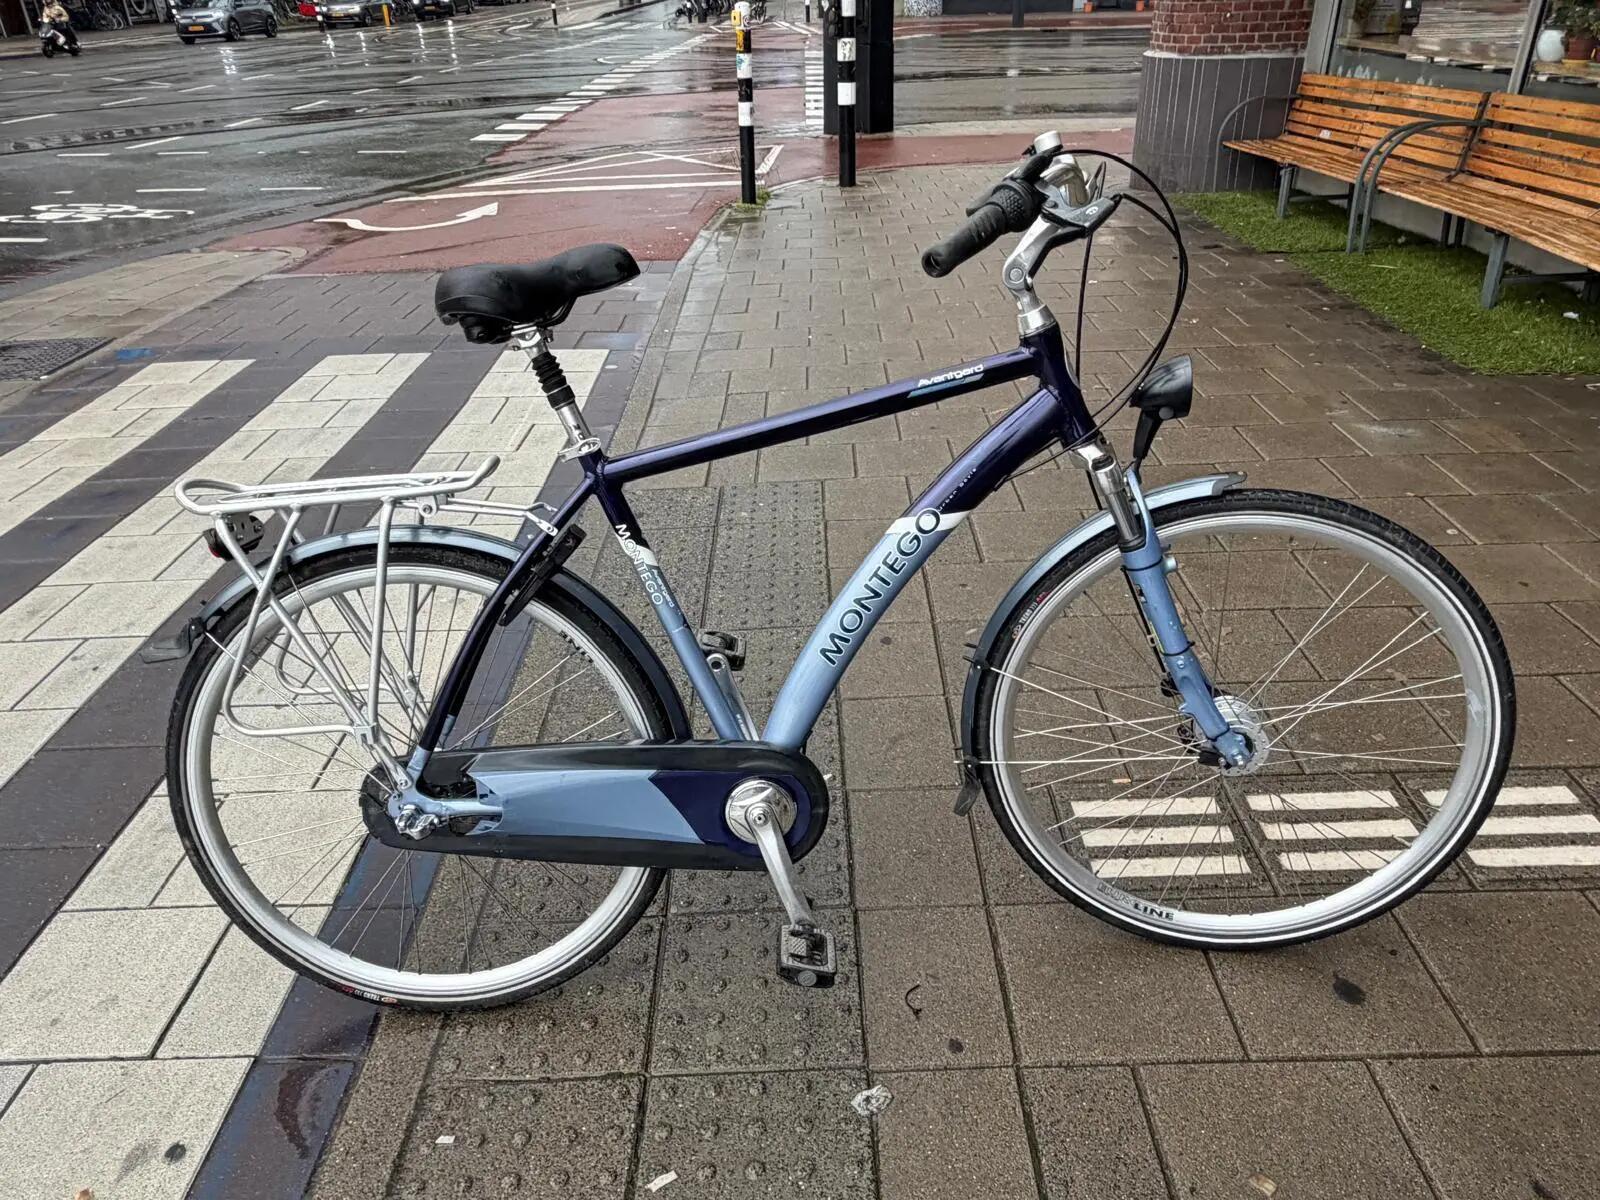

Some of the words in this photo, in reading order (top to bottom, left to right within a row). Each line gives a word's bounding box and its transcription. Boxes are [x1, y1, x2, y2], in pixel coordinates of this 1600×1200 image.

[917, 363, 984, 387] Avantgard
[615, 524, 663, 605] MONTEGO
[819, 507, 941, 667] MONTEGO
[1133, 902, 1174, 921] LINE
